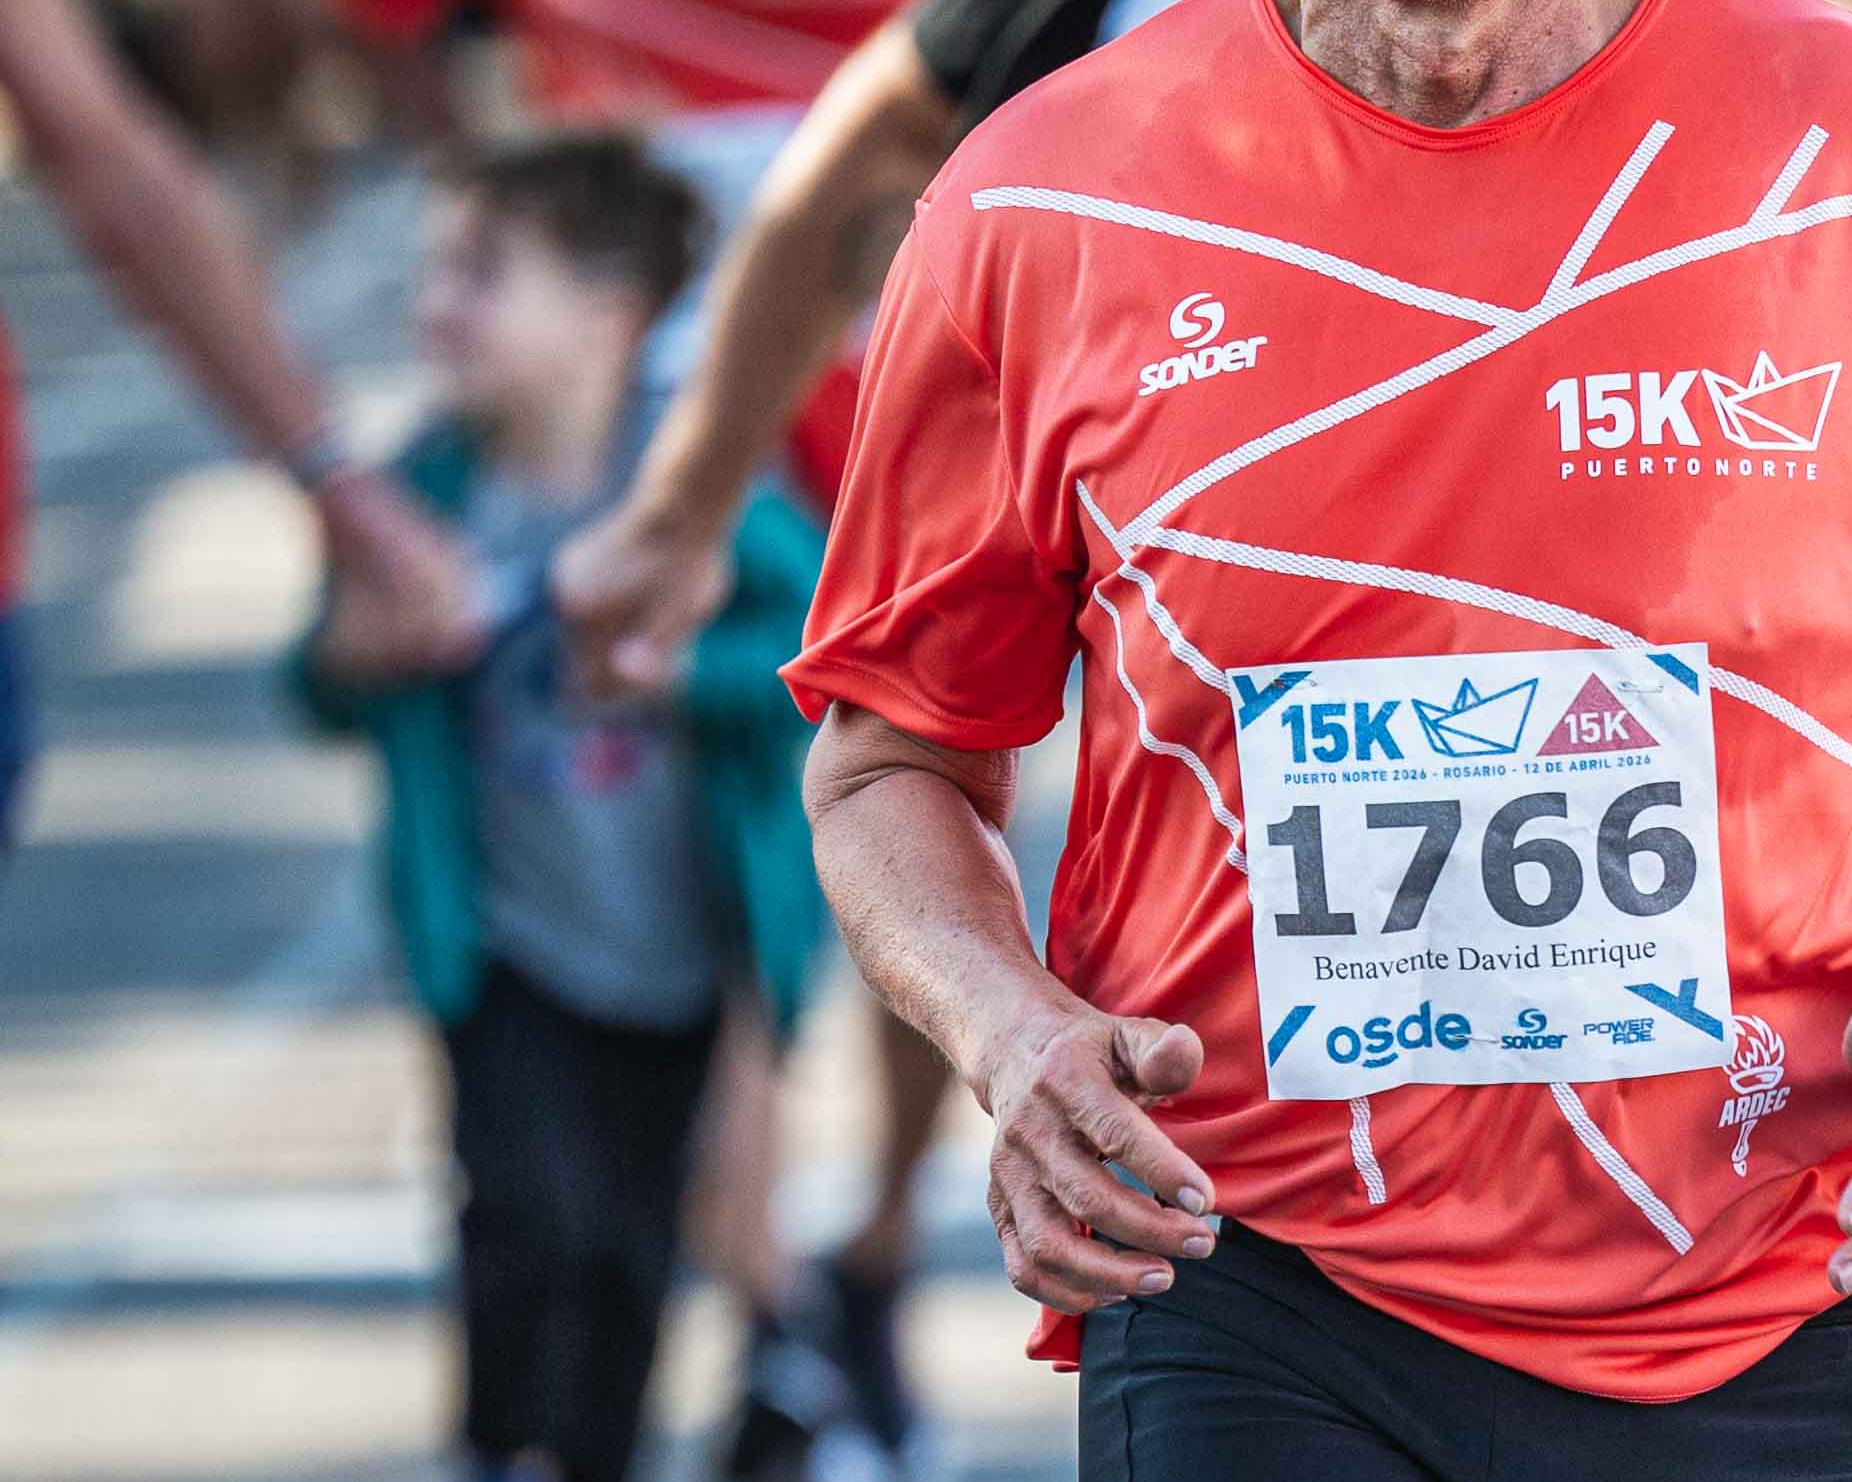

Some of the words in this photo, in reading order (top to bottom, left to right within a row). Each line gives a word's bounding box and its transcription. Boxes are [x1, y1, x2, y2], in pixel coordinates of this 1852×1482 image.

[1546, 370, 1701, 452] 15K
[1281, 700, 1404, 764] 15K
[1564, 709, 1631, 744] 15K
[1284, 772, 1336, 785] PUERTO
[1342, 770, 1387, 783] NORTE
[1393, 769, 1427, 781] 2026
[1443, 765, 1506, 778] ROSARIO
[1523, 763, 1539, 774] 12
[1545, 762, 1564, 773] DE
[1568, 758, 1611, 772] ABRIL
[1617, 754, 1651, 769] 2026
[1267, 782, 1697, 937] 1766
[1314, 949, 1449, 981] Benavente
[1457, 944, 1540, 971] David
[1550, 939, 1657, 968] Enrique
[1326, 999, 1472, 1064] osde
[1583, 1017, 1655, 1036] POWER
[1718, 1086, 1790, 1128] ARDEC
